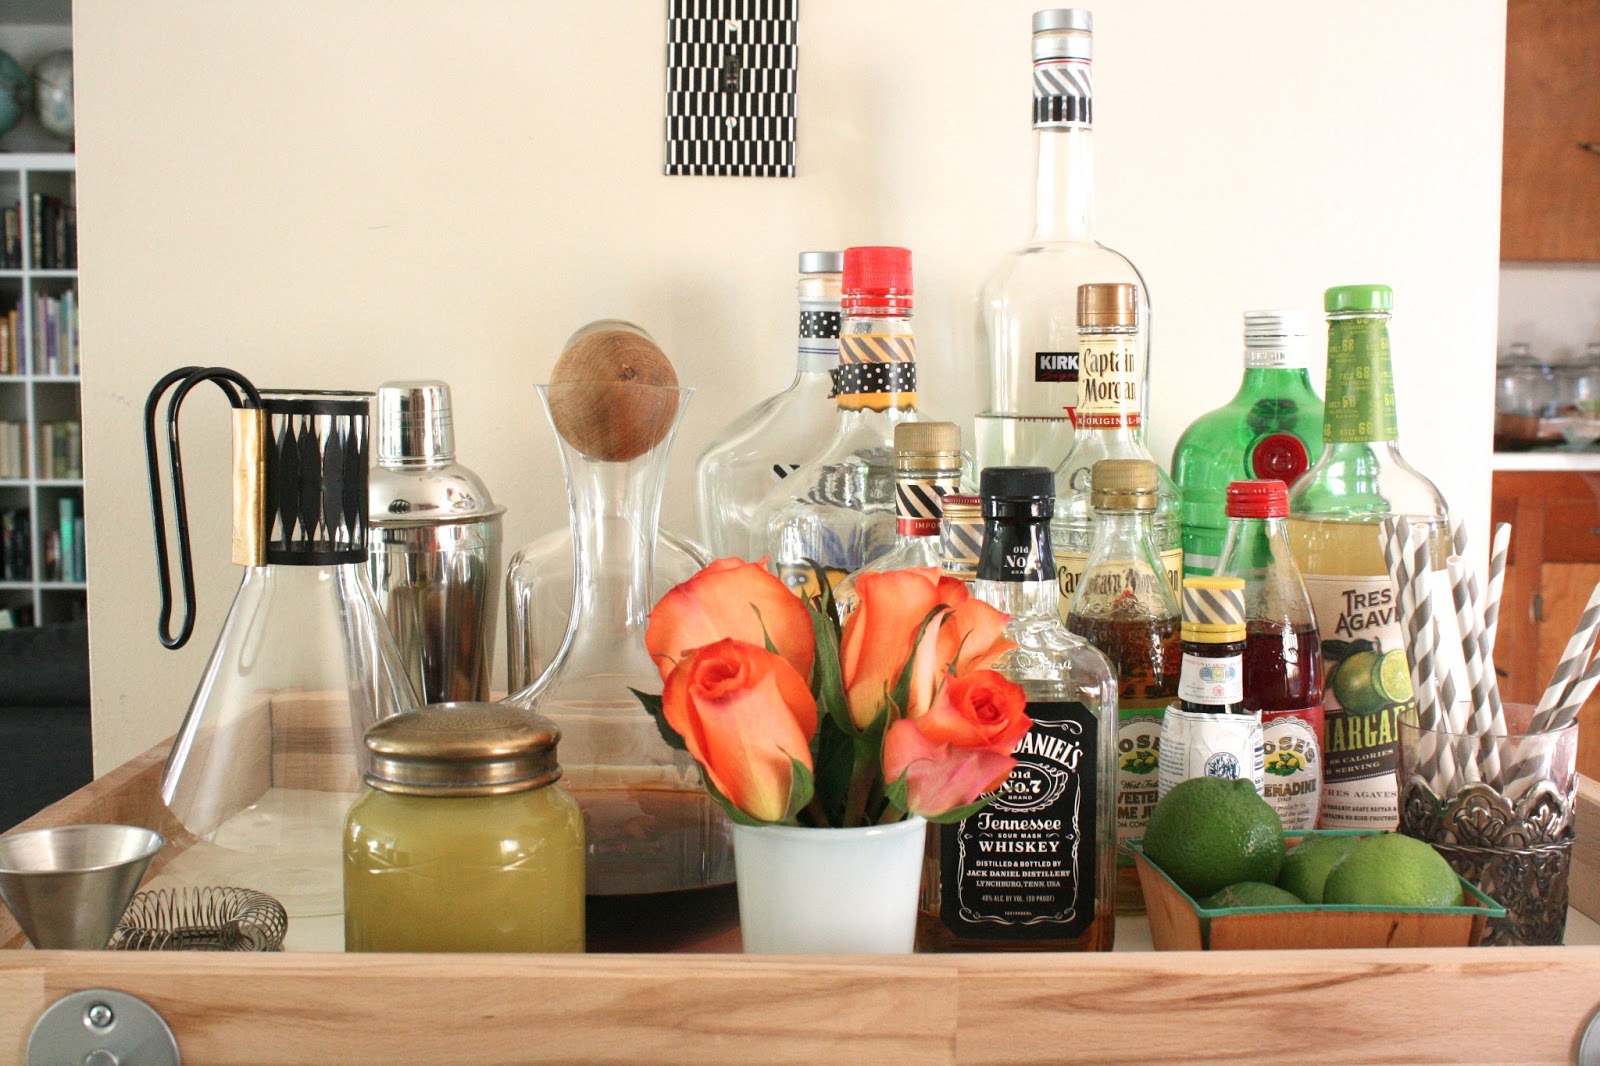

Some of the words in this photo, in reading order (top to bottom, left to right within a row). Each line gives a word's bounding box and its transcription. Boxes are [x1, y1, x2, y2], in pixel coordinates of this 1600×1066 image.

[1041, 355, 1078, 370] KIRK
[1084, 348, 1134, 377] Captain
[1342, 748, 1394, 763] CALORIES
[1335, 761, 1380, 774] SERVING
[1353, 790, 1397, 798] AGAVES
[978, 812, 1061, 831] Tennessee
[979, 841, 1060, 853] WHISKEY
[1021, 870, 1071, 878] DISTILLERY
